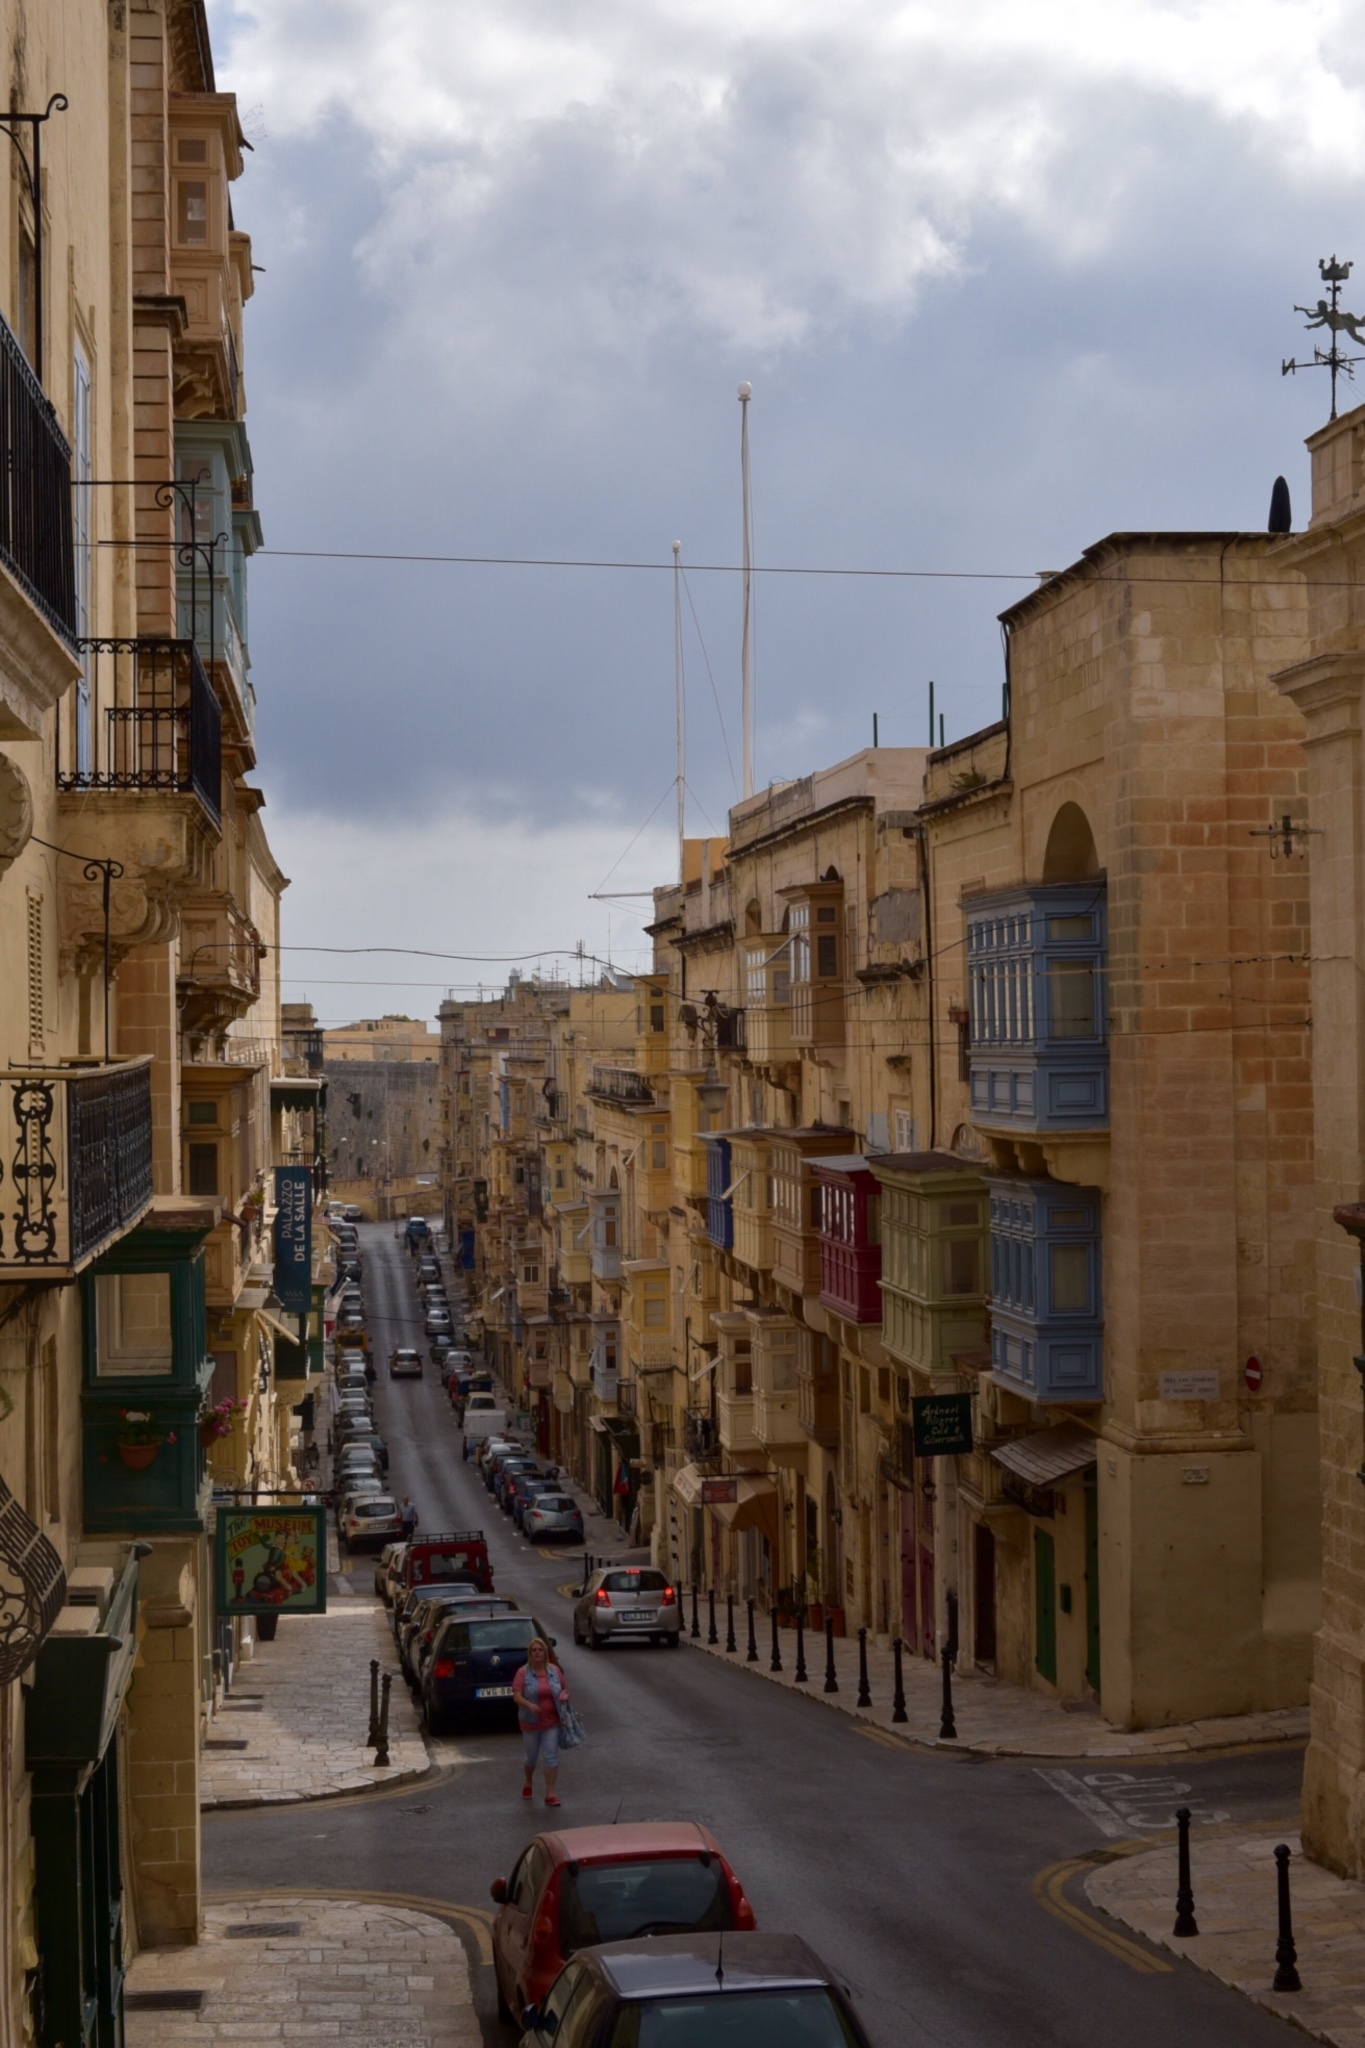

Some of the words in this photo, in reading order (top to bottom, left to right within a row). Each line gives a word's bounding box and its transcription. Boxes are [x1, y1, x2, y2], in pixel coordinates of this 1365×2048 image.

[281, 1179, 293, 1239] PALAZZO
[294, 1181, 306, 1222] SALLE
[294, 1223, 306, 1242] LA
[294, 1244, 306, 1262] DE
[227, 1516, 247, 1538] The
[230, 1534, 253, 1552] TOY
[254, 1518, 313, 1532] MUSEUM
